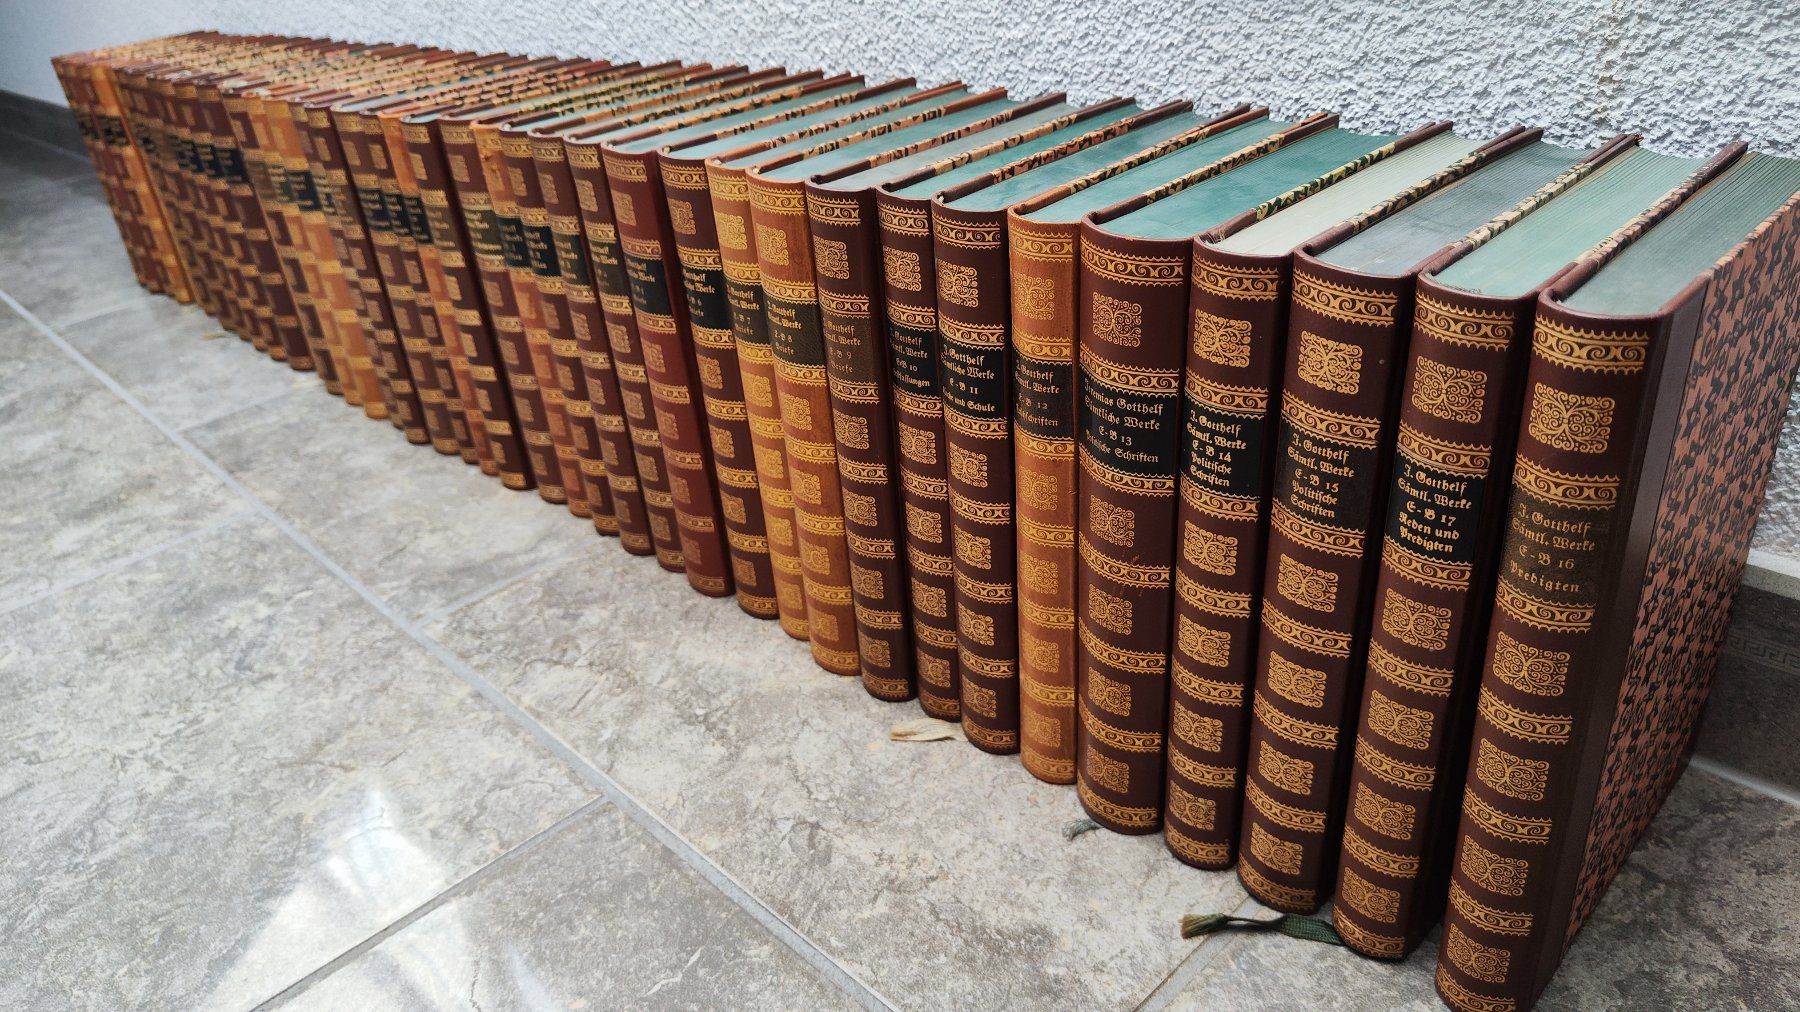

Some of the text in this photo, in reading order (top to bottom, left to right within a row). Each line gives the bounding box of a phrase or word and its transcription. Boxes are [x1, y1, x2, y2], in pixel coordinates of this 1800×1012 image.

[782, 318, 802, 330] Werke
[838, 336, 862, 346] Werke
[905, 346, 928, 358] Werke
[949, 348, 984, 366] Gotthelf
[910, 364, 918, 372] 10
[967, 366, 995, 380] Werke
[1033, 382, 1060, 394] Werke
[967, 400, 995, 412] Schule
[1037, 402, 1048, 410] 12
[1116, 397, 1164, 418] Gotthelf
[1124, 416, 1160, 430] Werke
[1198, 415, 1242, 438] Gotthelf
[1122, 436, 1132, 446] 13
[1214, 435, 1248, 450] Werke
[1292, 433, 1350, 464] J. Gotthelf
[1114, 447, 1159, 464] Schriften
[1218, 452, 1232, 462] 14
[1287, 446, 1355, 478] Sämtl. Werke
[1190, 464, 1230, 486] Schriften
[1404, 464, 1468, 496] J. Gotthelf
[1325, 482, 1340, 493] 15
[1398, 477, 1473, 509] Sämtl. Werke
[1290, 494, 1336, 518] Schriften
[1398, 511, 1460, 542] Reden und
[1440, 514, 1457, 526] 17
[1518, 502, 1592, 538] J. Gotthelf
[1400, 526, 1454, 552] Predigten
[1511, 518, 1595, 551] Sämtl. Werke
[1558, 558, 1575, 570] 16
[1510, 560, 1581, 592] Predigten
